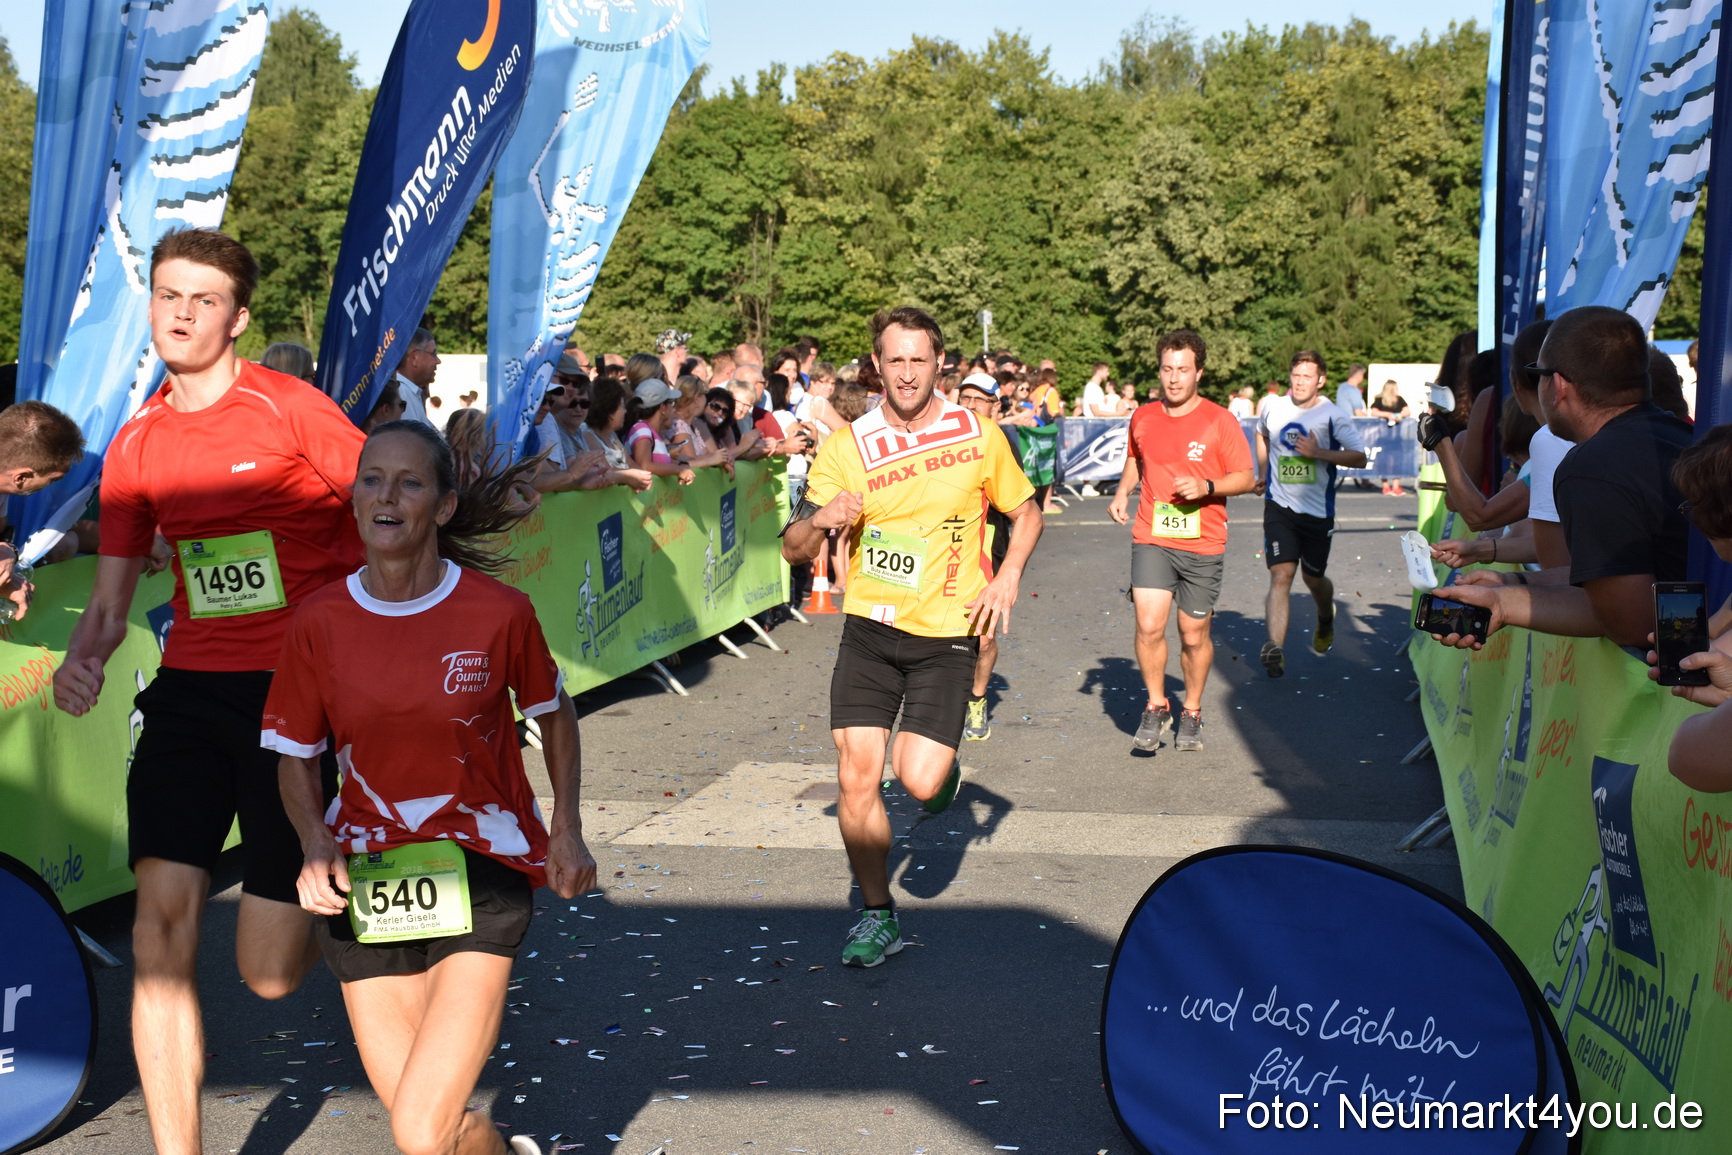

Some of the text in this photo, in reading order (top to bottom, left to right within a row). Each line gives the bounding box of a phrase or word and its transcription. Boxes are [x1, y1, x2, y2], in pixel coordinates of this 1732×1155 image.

[425, 43, 522, 226] Druck und Medien
[342, 85, 473, 338] Frischmann
[867, 446, 985, 493] MAX BÖGL
[1282, 465, 1310, 476] 2021
[1162, 516, 1187, 529] 451
[193, 561, 266, 596] 1496
[866, 547, 915, 575] 1209
[233, 591, 259, 602] Lukas
[596, 560, 645, 632] firmenlauf
[441, 651, 488, 672] Town
[443, 668, 491, 695] Country
[461, 684, 483, 693] HAUS
[1598, 818, 1629, 858] Fischer
[1606, 858, 1633, 879] AUTOMOBILE
[371, 877, 438, 915] 540
[376, 912, 437, 926] Kerler Gisela
[391, 924, 419, 932] Hausbau
[420, 921, 441, 929] GmbH
[1180, 987, 1245, 1031] und
[1252, 984, 1314, 1037] das
[1318, 998, 1481, 1060] Lächeln
[1587, 918, 1700, 1093] firmenlauf
[1248, 1046, 1349, 1101] fährt
[1573, 1033, 1629, 1095] neumarkt
